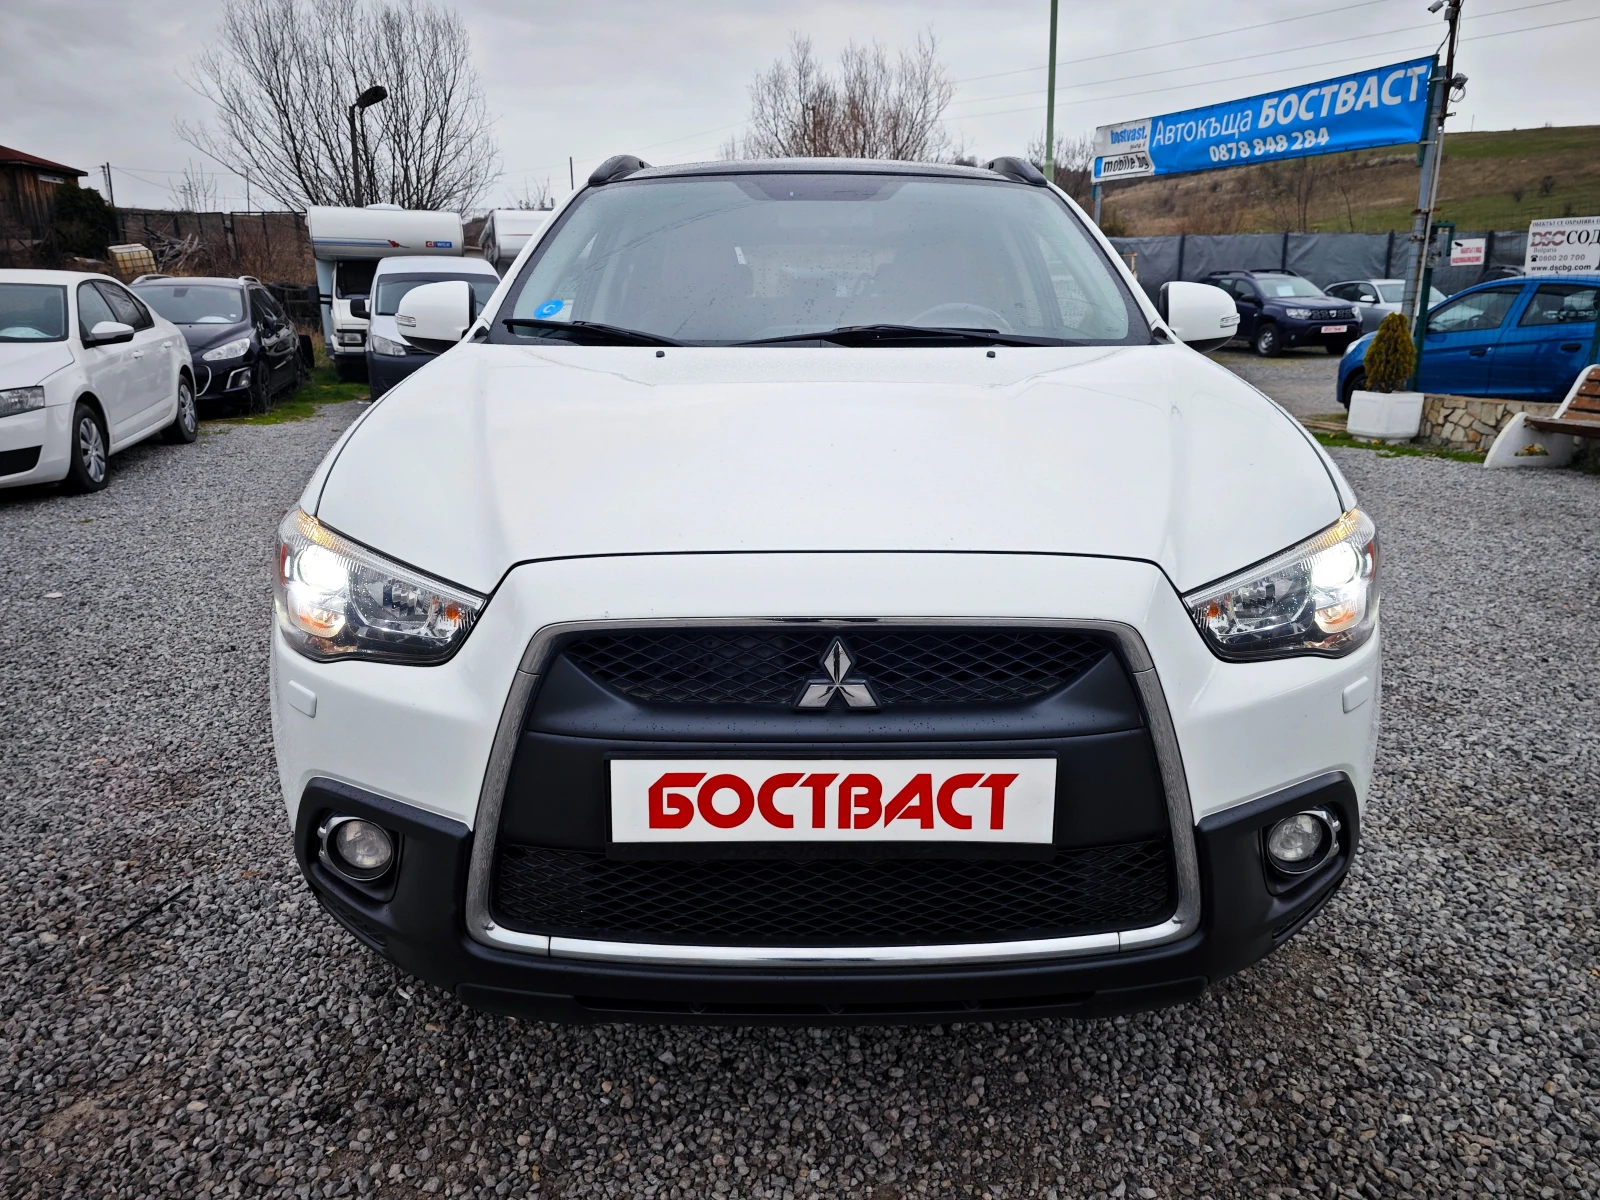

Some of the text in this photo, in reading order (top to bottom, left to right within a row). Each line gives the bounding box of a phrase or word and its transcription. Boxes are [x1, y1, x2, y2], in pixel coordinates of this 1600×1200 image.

[1152, 65, 1427, 147] Автокъща БОСТВАСТ
[1209, 127, 1329, 162] 0878 848 284
[1103, 154, 1149, 173] mobile.bg
[1530, 230, 1566, 247] DSC
[1531, 264, 1592, 272] www.dscbg.com
[648, 772, 1020, 830] БОСТВАСТ
